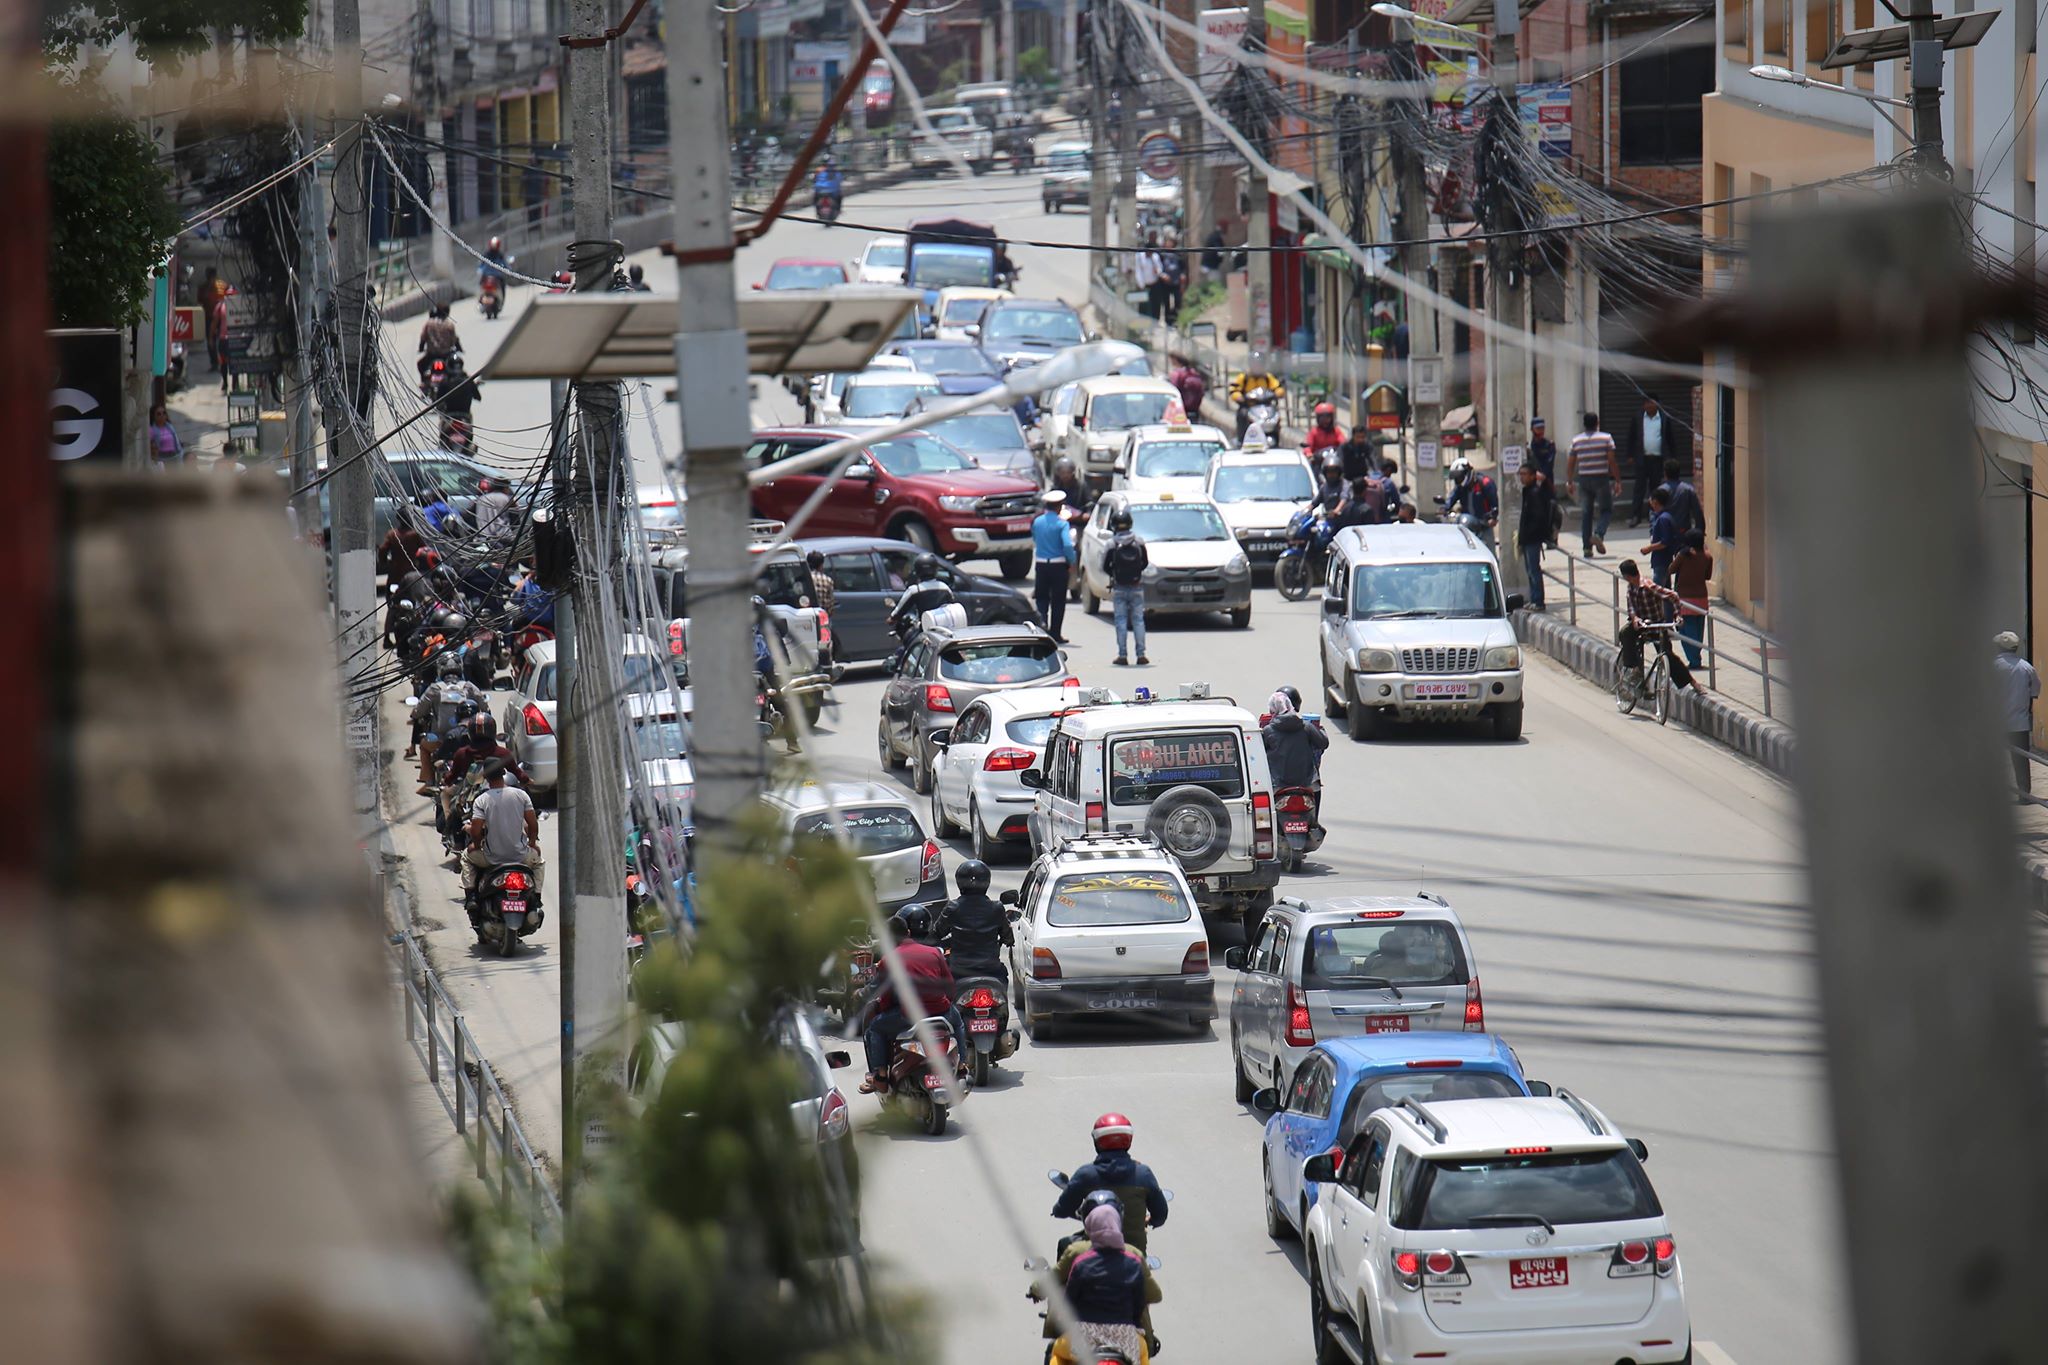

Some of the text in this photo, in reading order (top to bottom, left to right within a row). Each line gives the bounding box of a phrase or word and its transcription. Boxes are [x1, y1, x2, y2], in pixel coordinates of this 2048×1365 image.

[48, 387, 104, 460] G
[1124, 740, 1235, 769] AMBULANCE
[876, 816, 890, 824] Cab
[1156, 891, 1178, 905] TAXI
